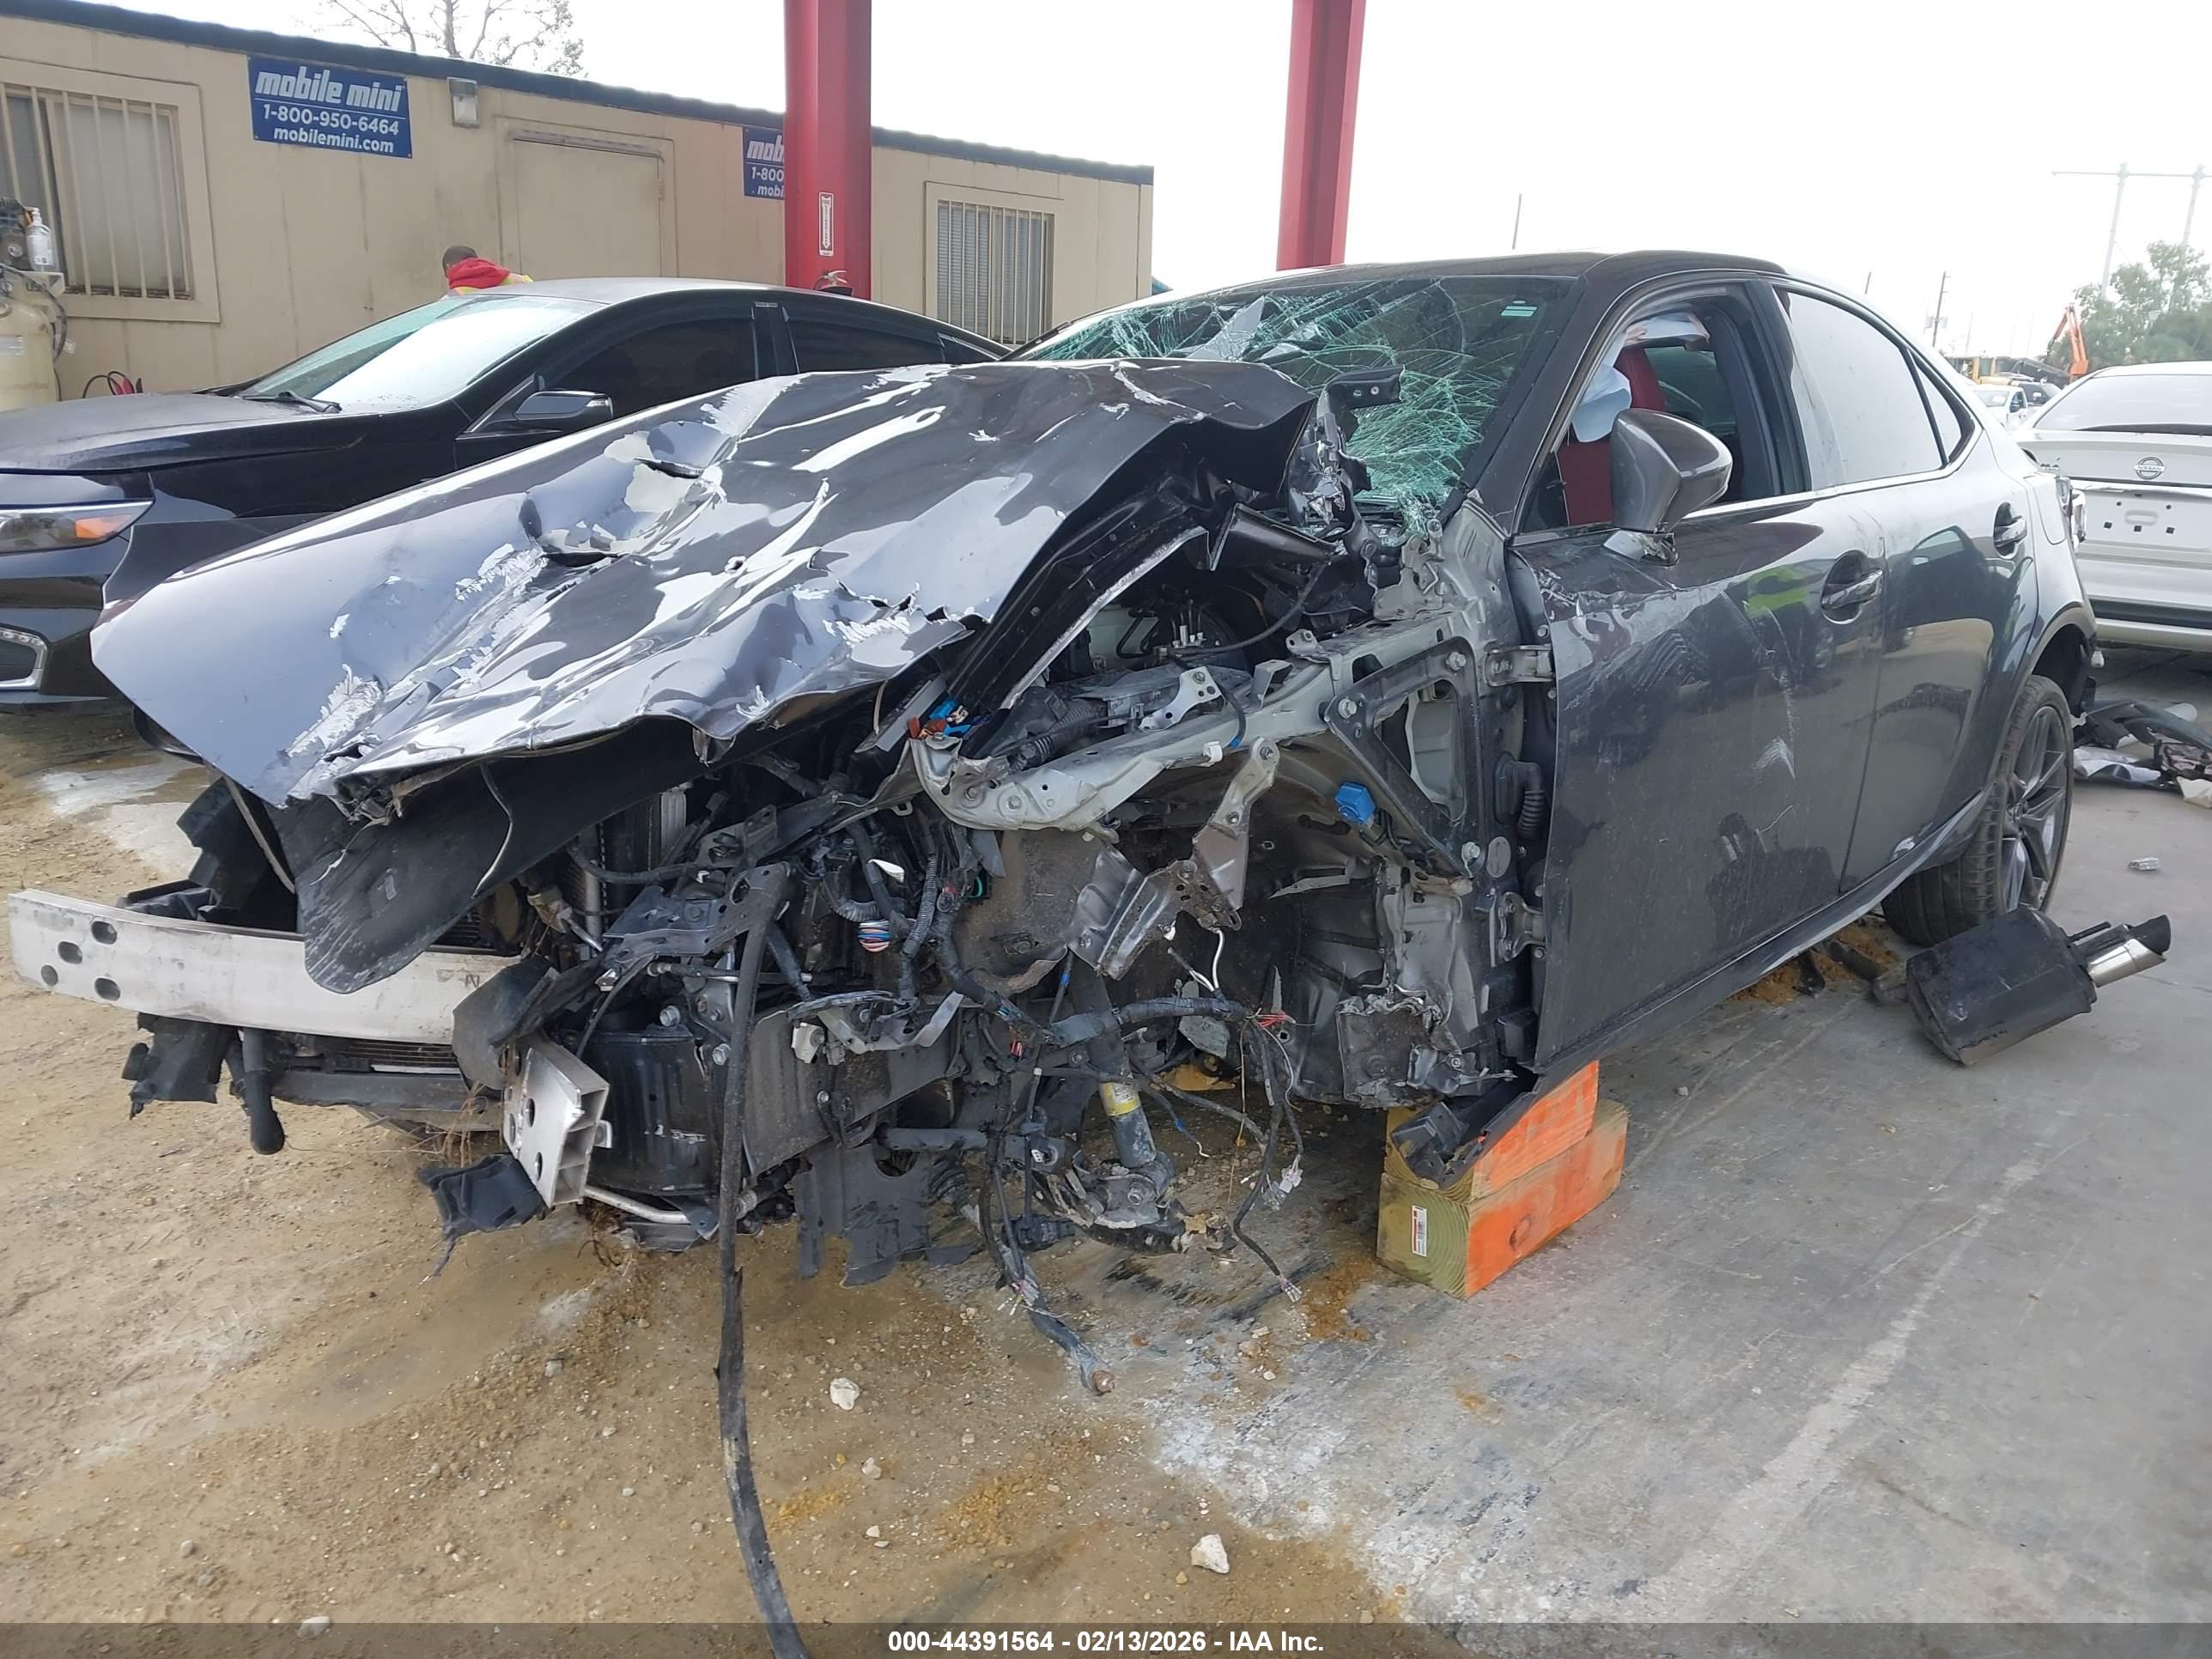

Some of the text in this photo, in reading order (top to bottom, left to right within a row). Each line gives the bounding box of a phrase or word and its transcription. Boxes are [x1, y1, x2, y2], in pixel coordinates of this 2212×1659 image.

[255, 66, 404, 112] mobile mini
[263, 104, 399, 136] 1-800-950-6464
[274, 127, 393, 153] mobilemini.com
[746, 135, 785, 162] mob
